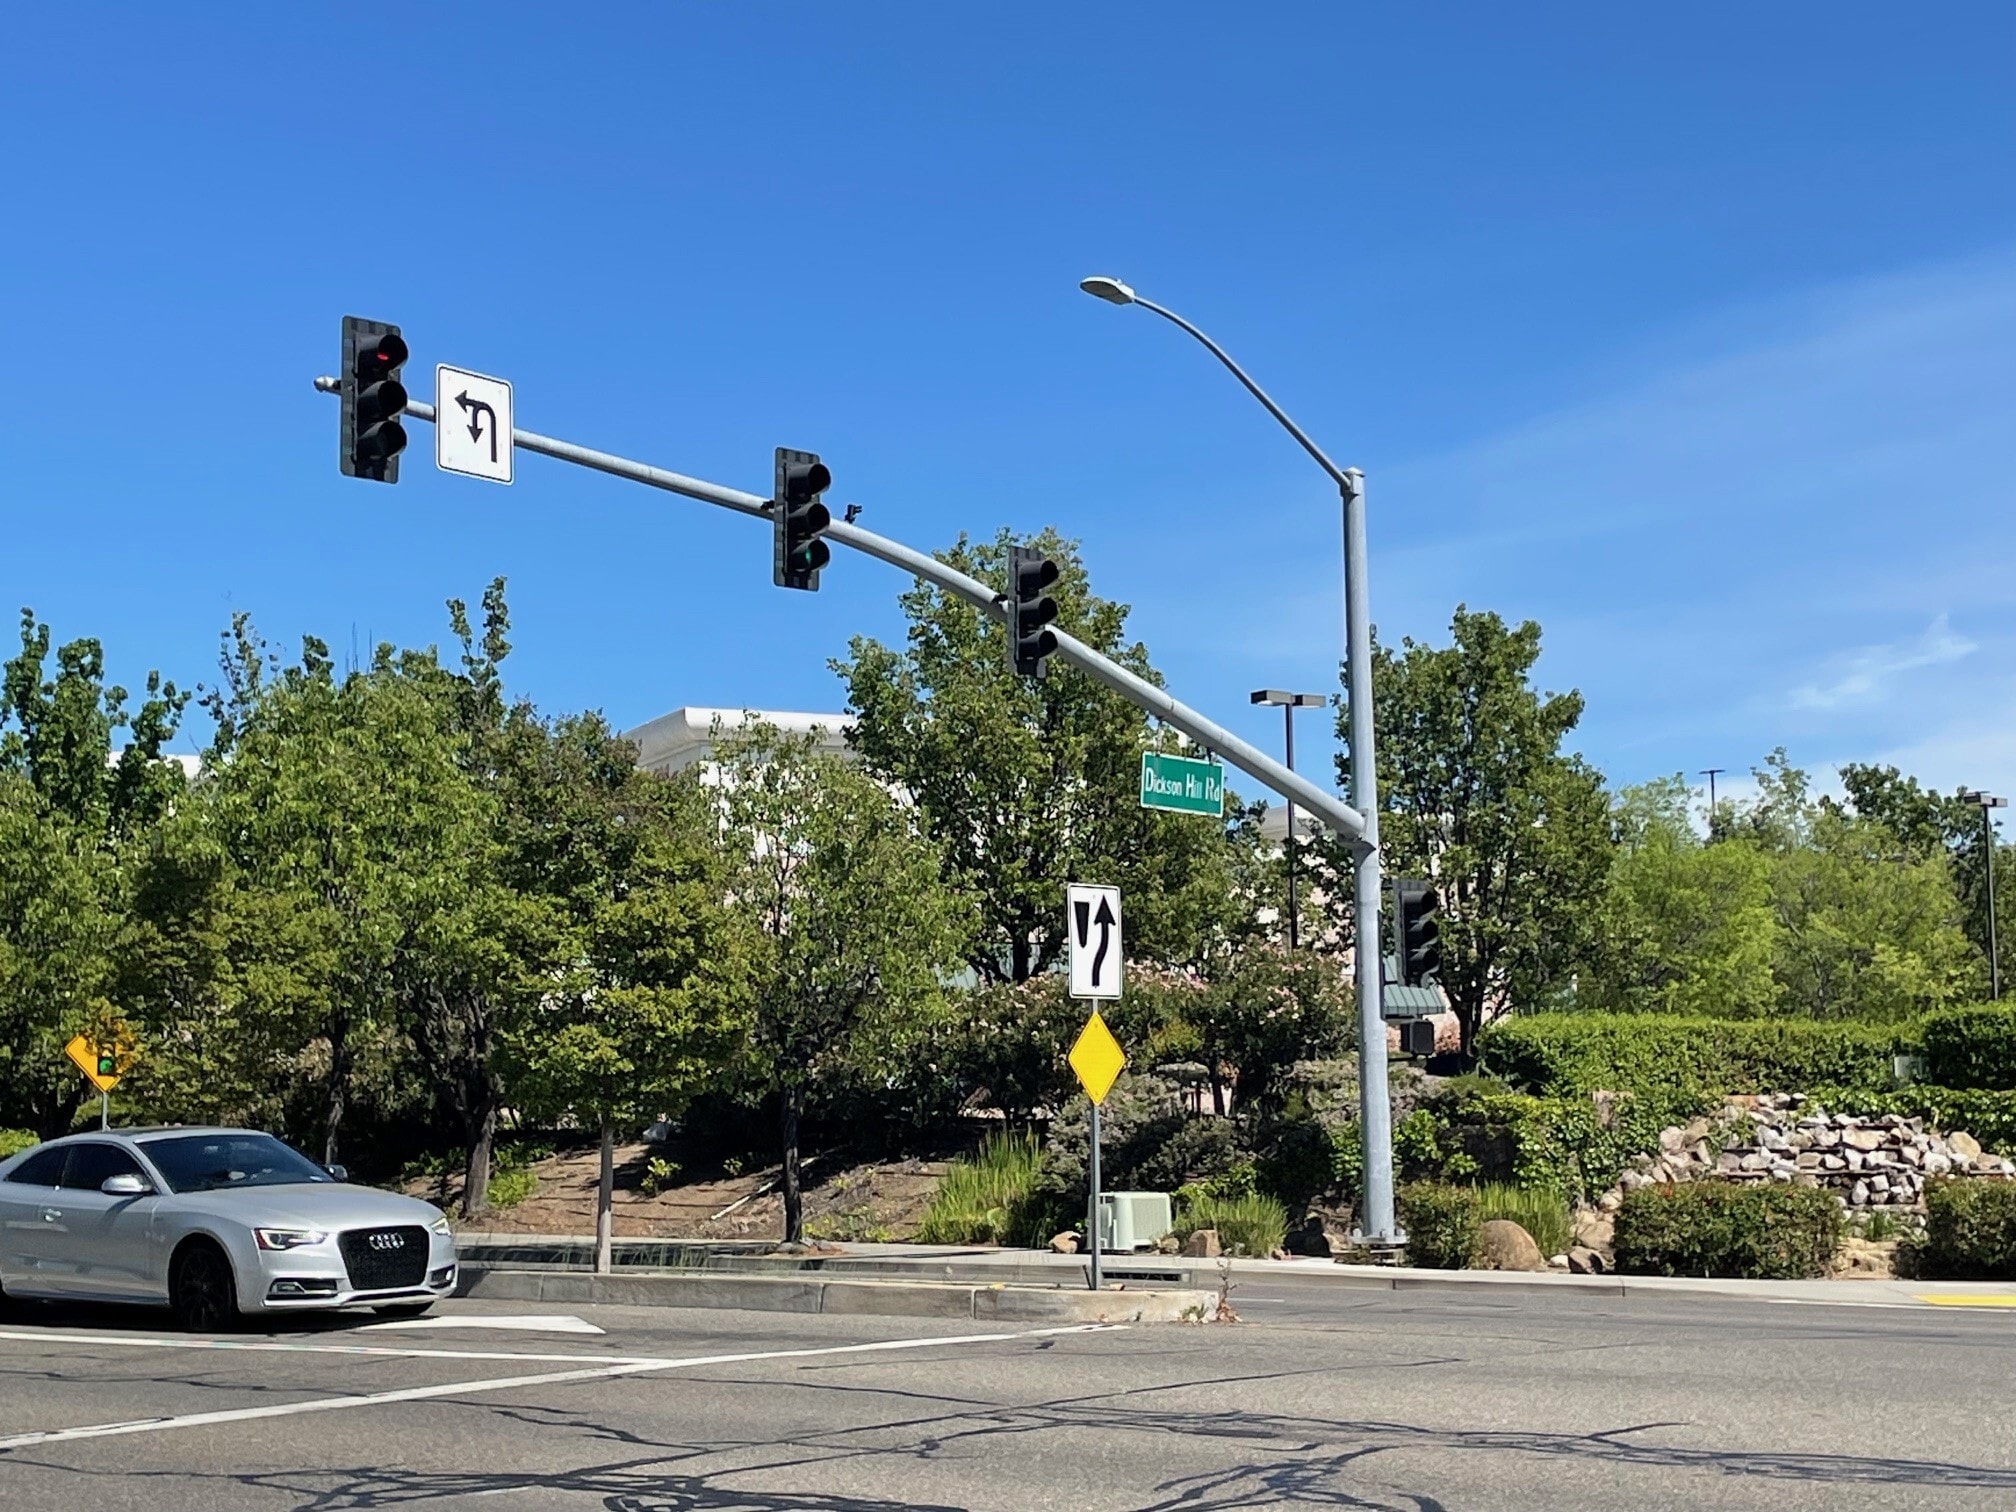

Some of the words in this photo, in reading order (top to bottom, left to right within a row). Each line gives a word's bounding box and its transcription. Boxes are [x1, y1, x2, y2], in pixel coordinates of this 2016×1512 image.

[1145, 767, 1182, 796] Dickson
[1186, 773, 1203, 799] Hill
[1205, 777, 1220, 802] Rd
